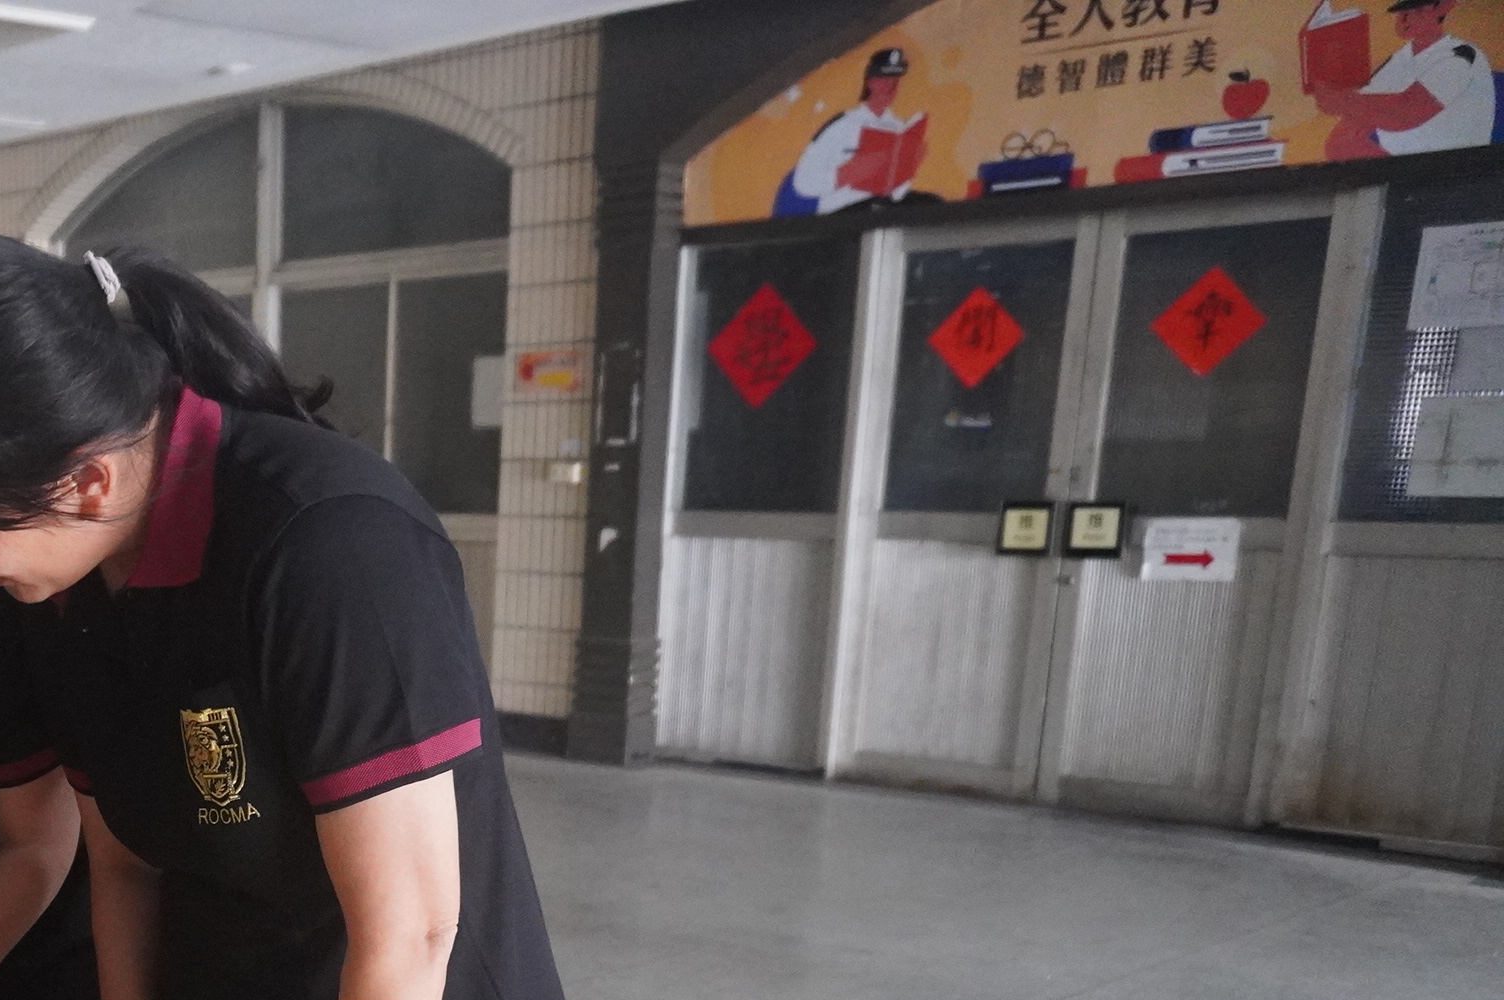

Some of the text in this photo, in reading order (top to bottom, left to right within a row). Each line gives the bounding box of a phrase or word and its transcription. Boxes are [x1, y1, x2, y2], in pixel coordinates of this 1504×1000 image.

[1016, 36, 1217, 100] 德智體群美
[198, 802, 261, 825] ROCMA
